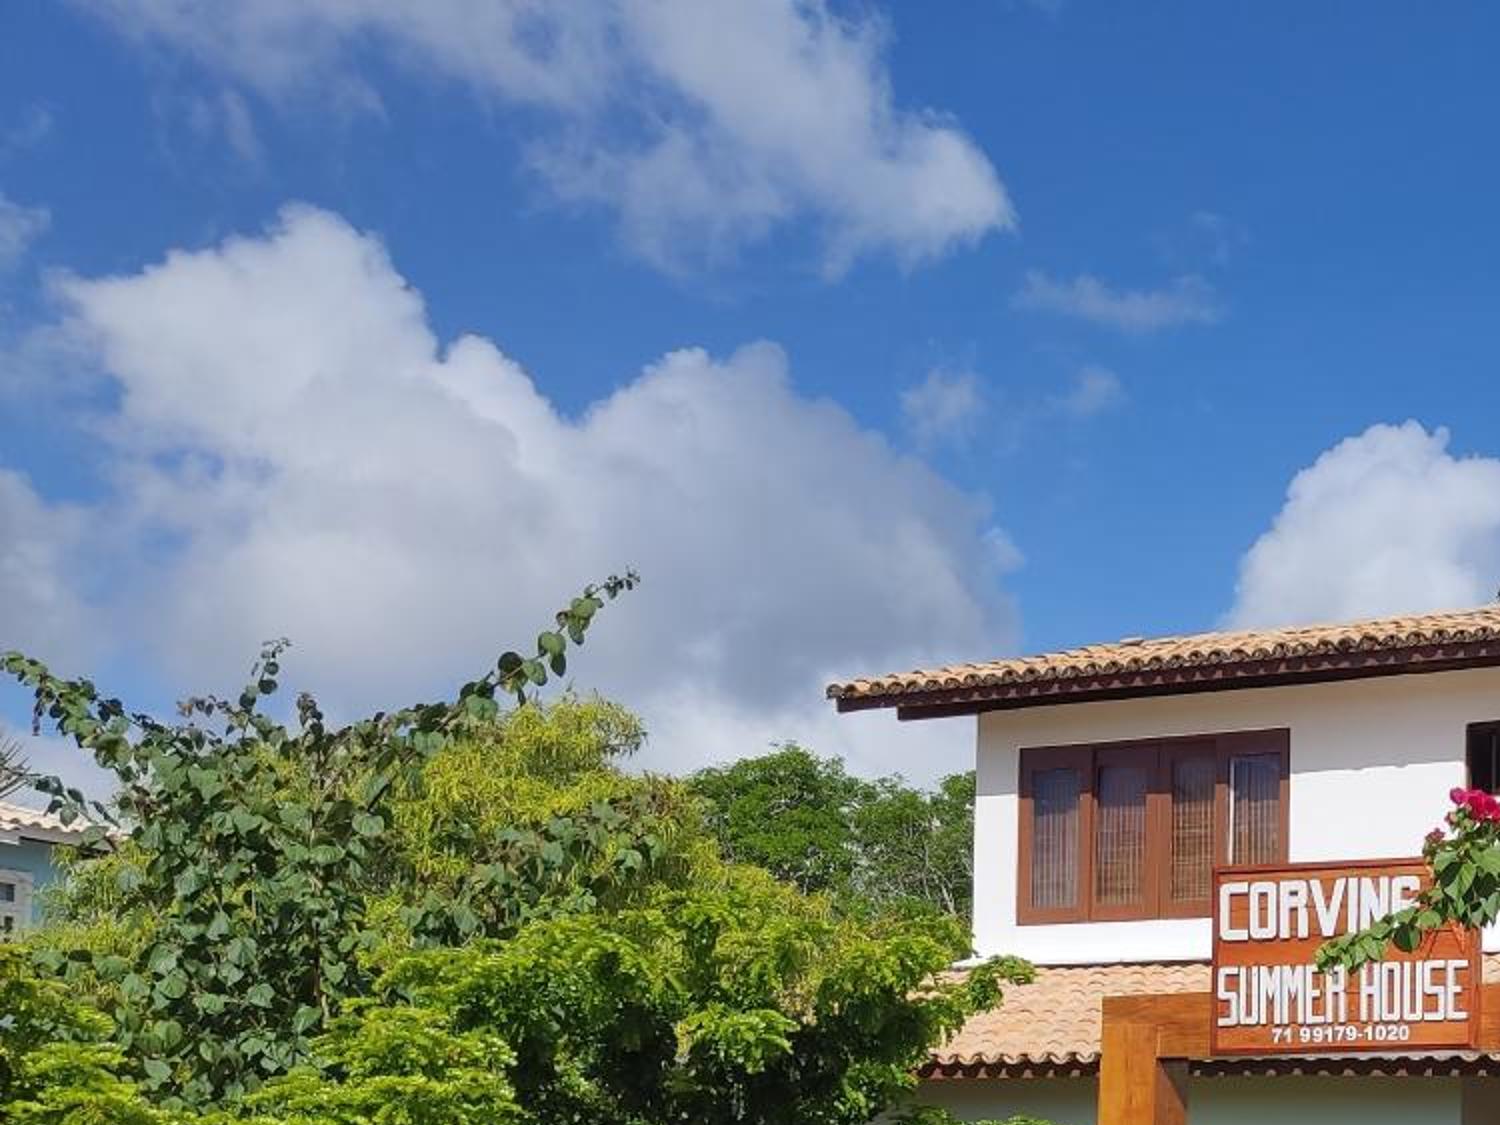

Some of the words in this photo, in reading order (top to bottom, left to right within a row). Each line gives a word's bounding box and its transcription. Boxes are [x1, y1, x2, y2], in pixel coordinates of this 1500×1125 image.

[1217, 964, 1346, 1027] SUMMER
[1360, 959, 1469, 1022] HOUSE
[1271, 1028, 1292, 1044] 71
[1299, 1025, 1409, 1043] 99179-1020
